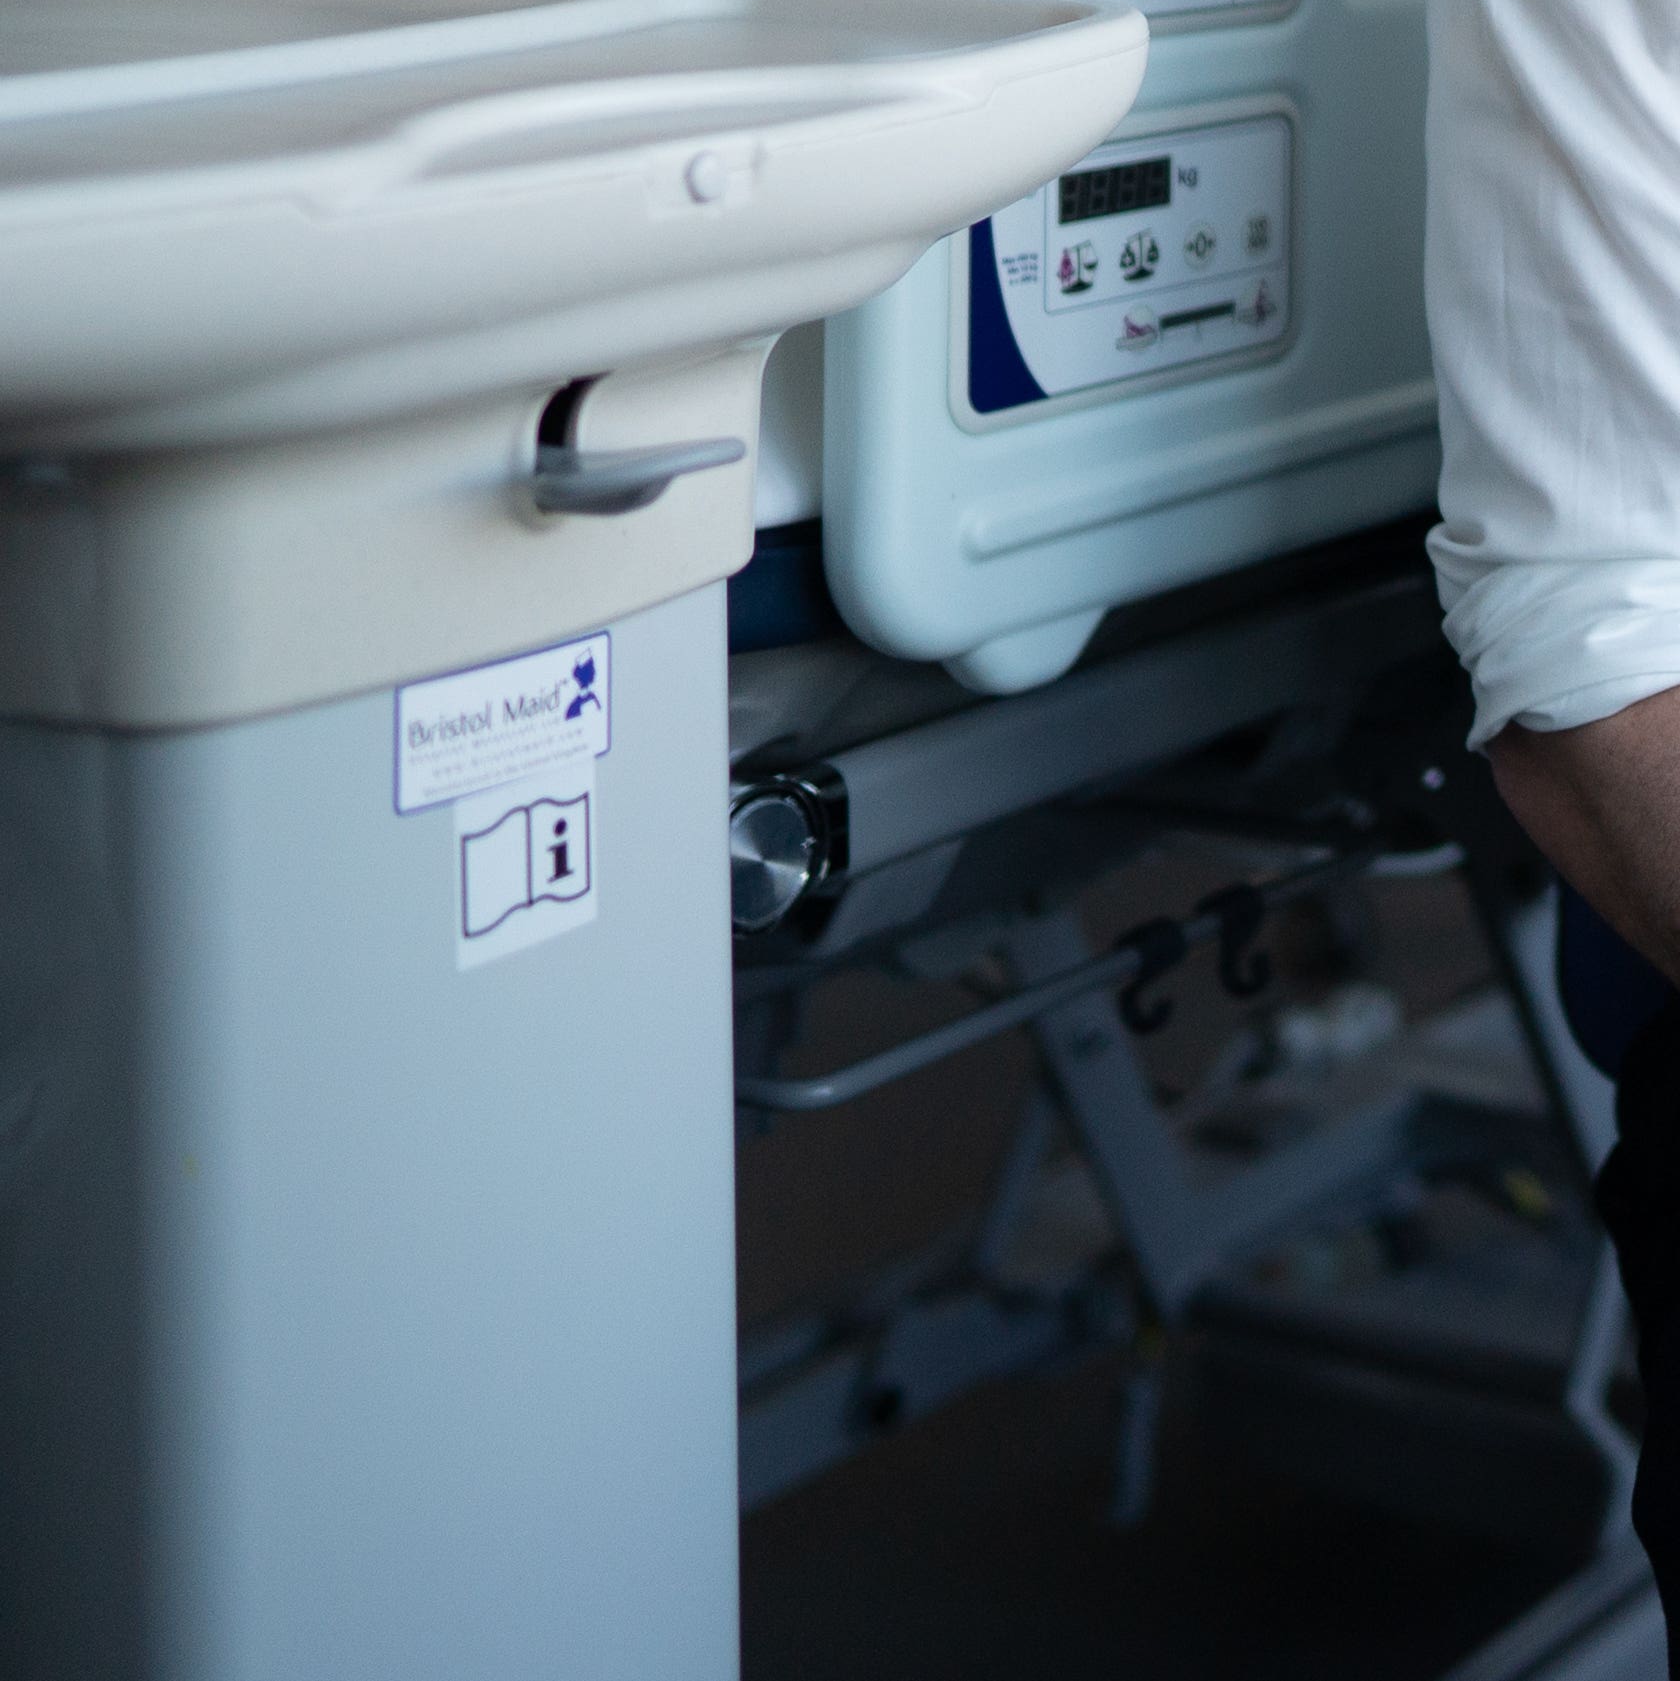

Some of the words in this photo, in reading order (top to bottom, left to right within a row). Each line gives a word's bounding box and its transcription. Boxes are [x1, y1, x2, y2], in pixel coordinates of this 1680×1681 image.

[1177, 167, 1198, 189] kg
[408, 698, 492, 749] Bristol
[502, 681, 561, 724] Maid
